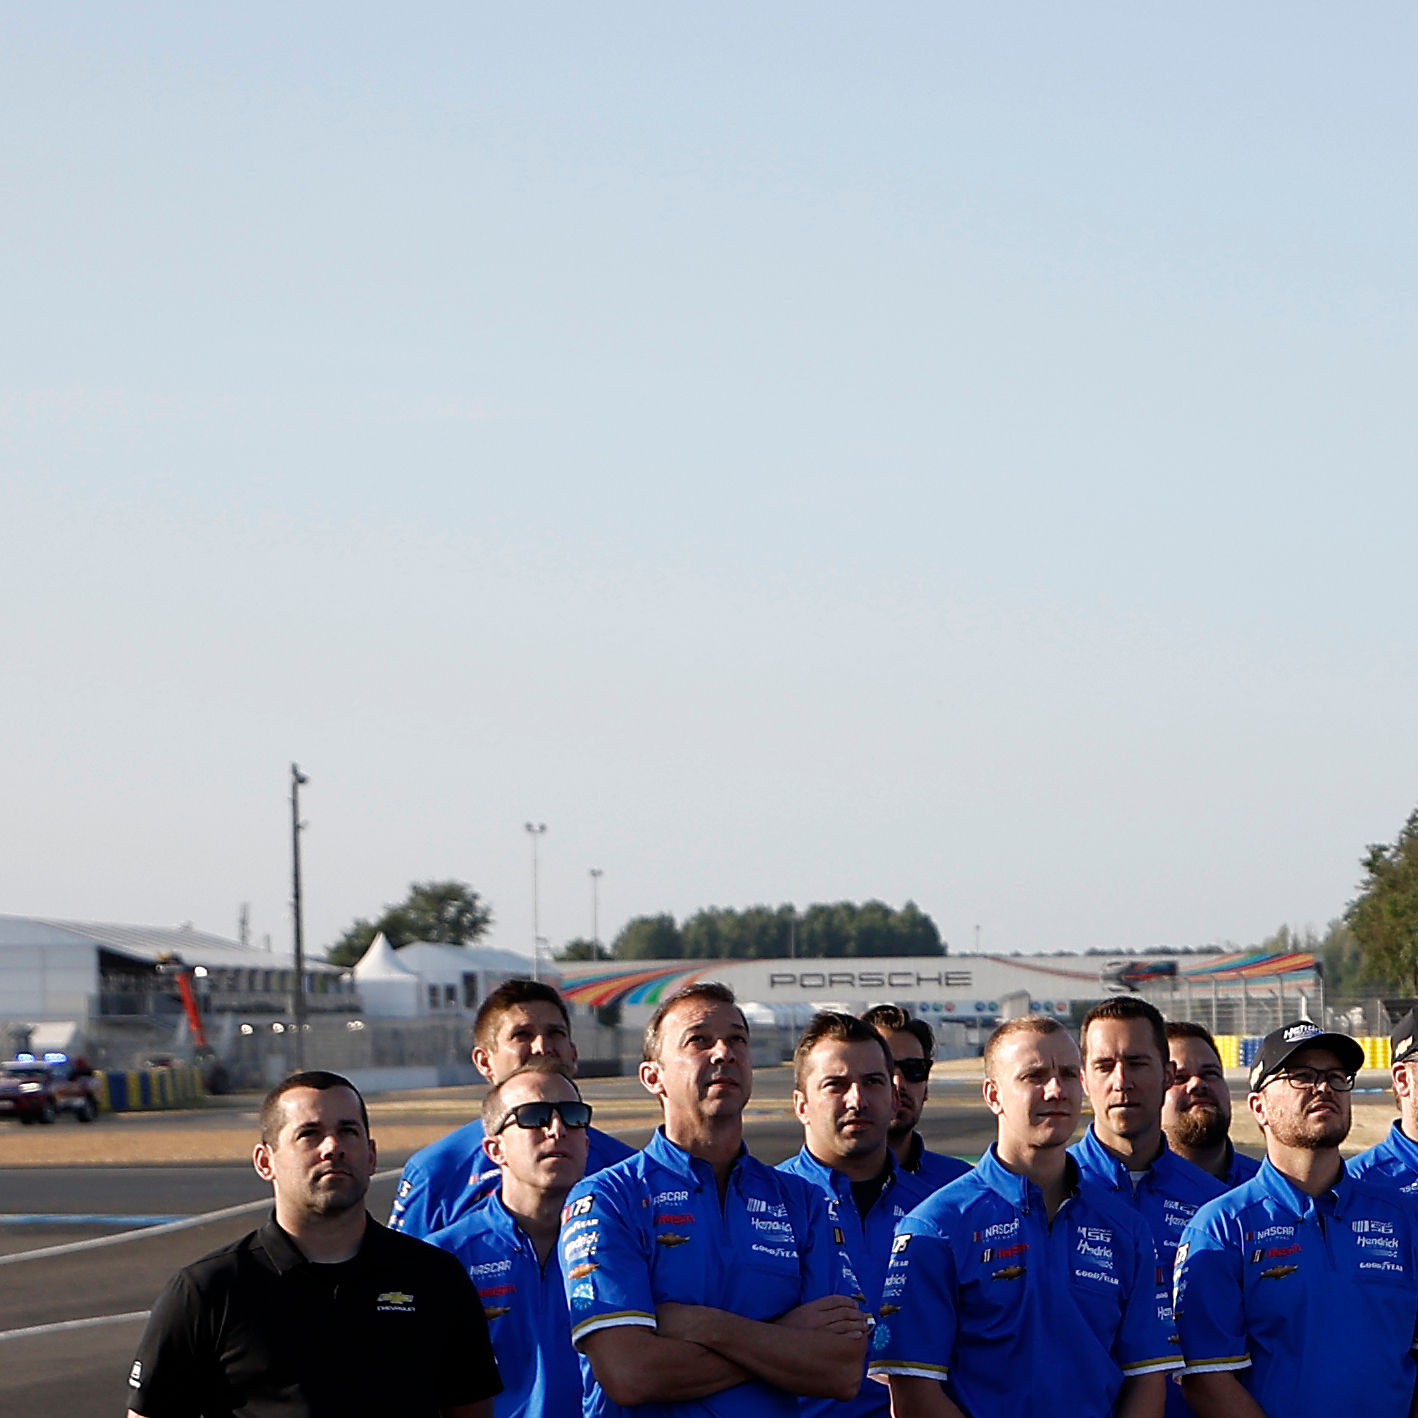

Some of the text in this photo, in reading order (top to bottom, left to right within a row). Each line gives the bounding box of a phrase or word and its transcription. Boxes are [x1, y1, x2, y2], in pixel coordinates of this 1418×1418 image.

[770, 971, 973, 988] PORSCHE
[573, 1195, 594, 1217] 75
[1258, 1226, 1295, 1240] NASCAR
[1357, 1236, 1399, 1249] Hendrick
[752, 1244, 800, 1259] GOODYEA
[1360, 1261, 1404, 1272] GOODYEAR
